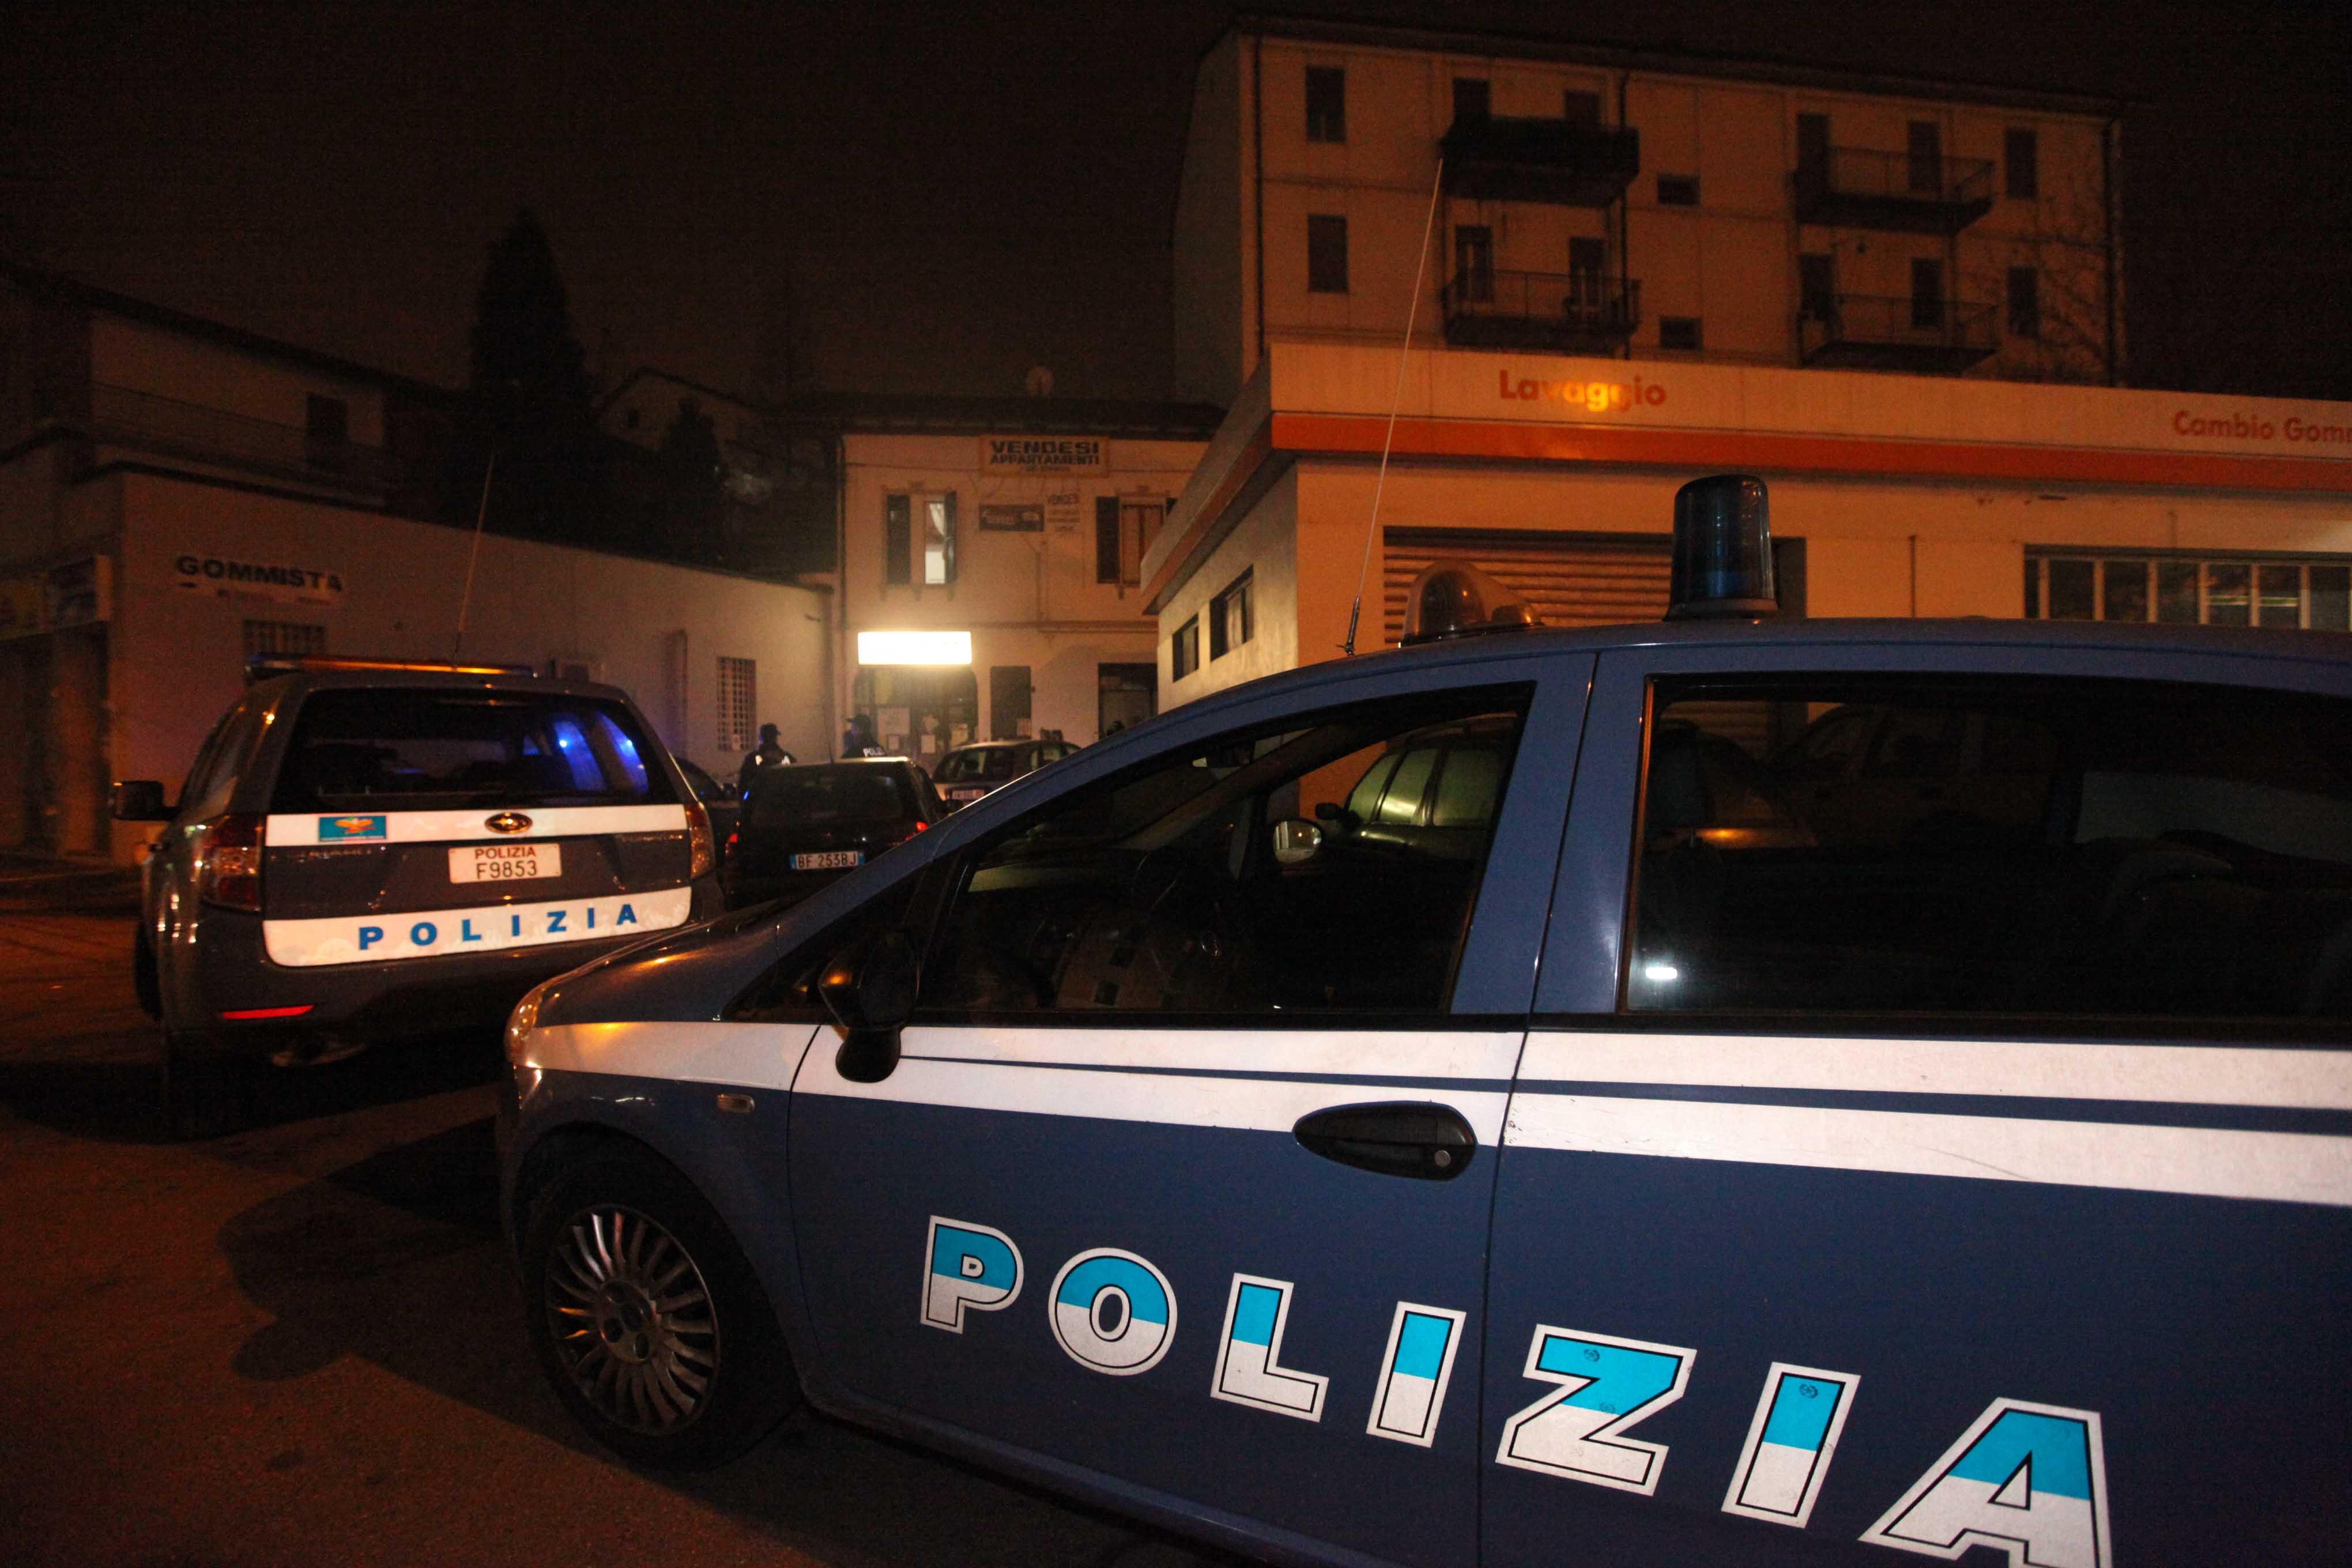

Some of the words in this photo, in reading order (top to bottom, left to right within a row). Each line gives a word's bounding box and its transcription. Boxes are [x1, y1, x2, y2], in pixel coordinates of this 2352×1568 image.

[1499, 370, 1666, 413] Lavaggio
[2173, 410, 2274, 440] Cambio
[990, 440, 1099, 453] VENDESI
[178, 556, 342, 592] GOMMISTA
[475, 847, 536, 859] POLIZIA
[476, 861, 537, 879] F9853
[359, 904, 637, 950] POLIZIA
[919, 1214, 2113, 1568] POLIZIA
